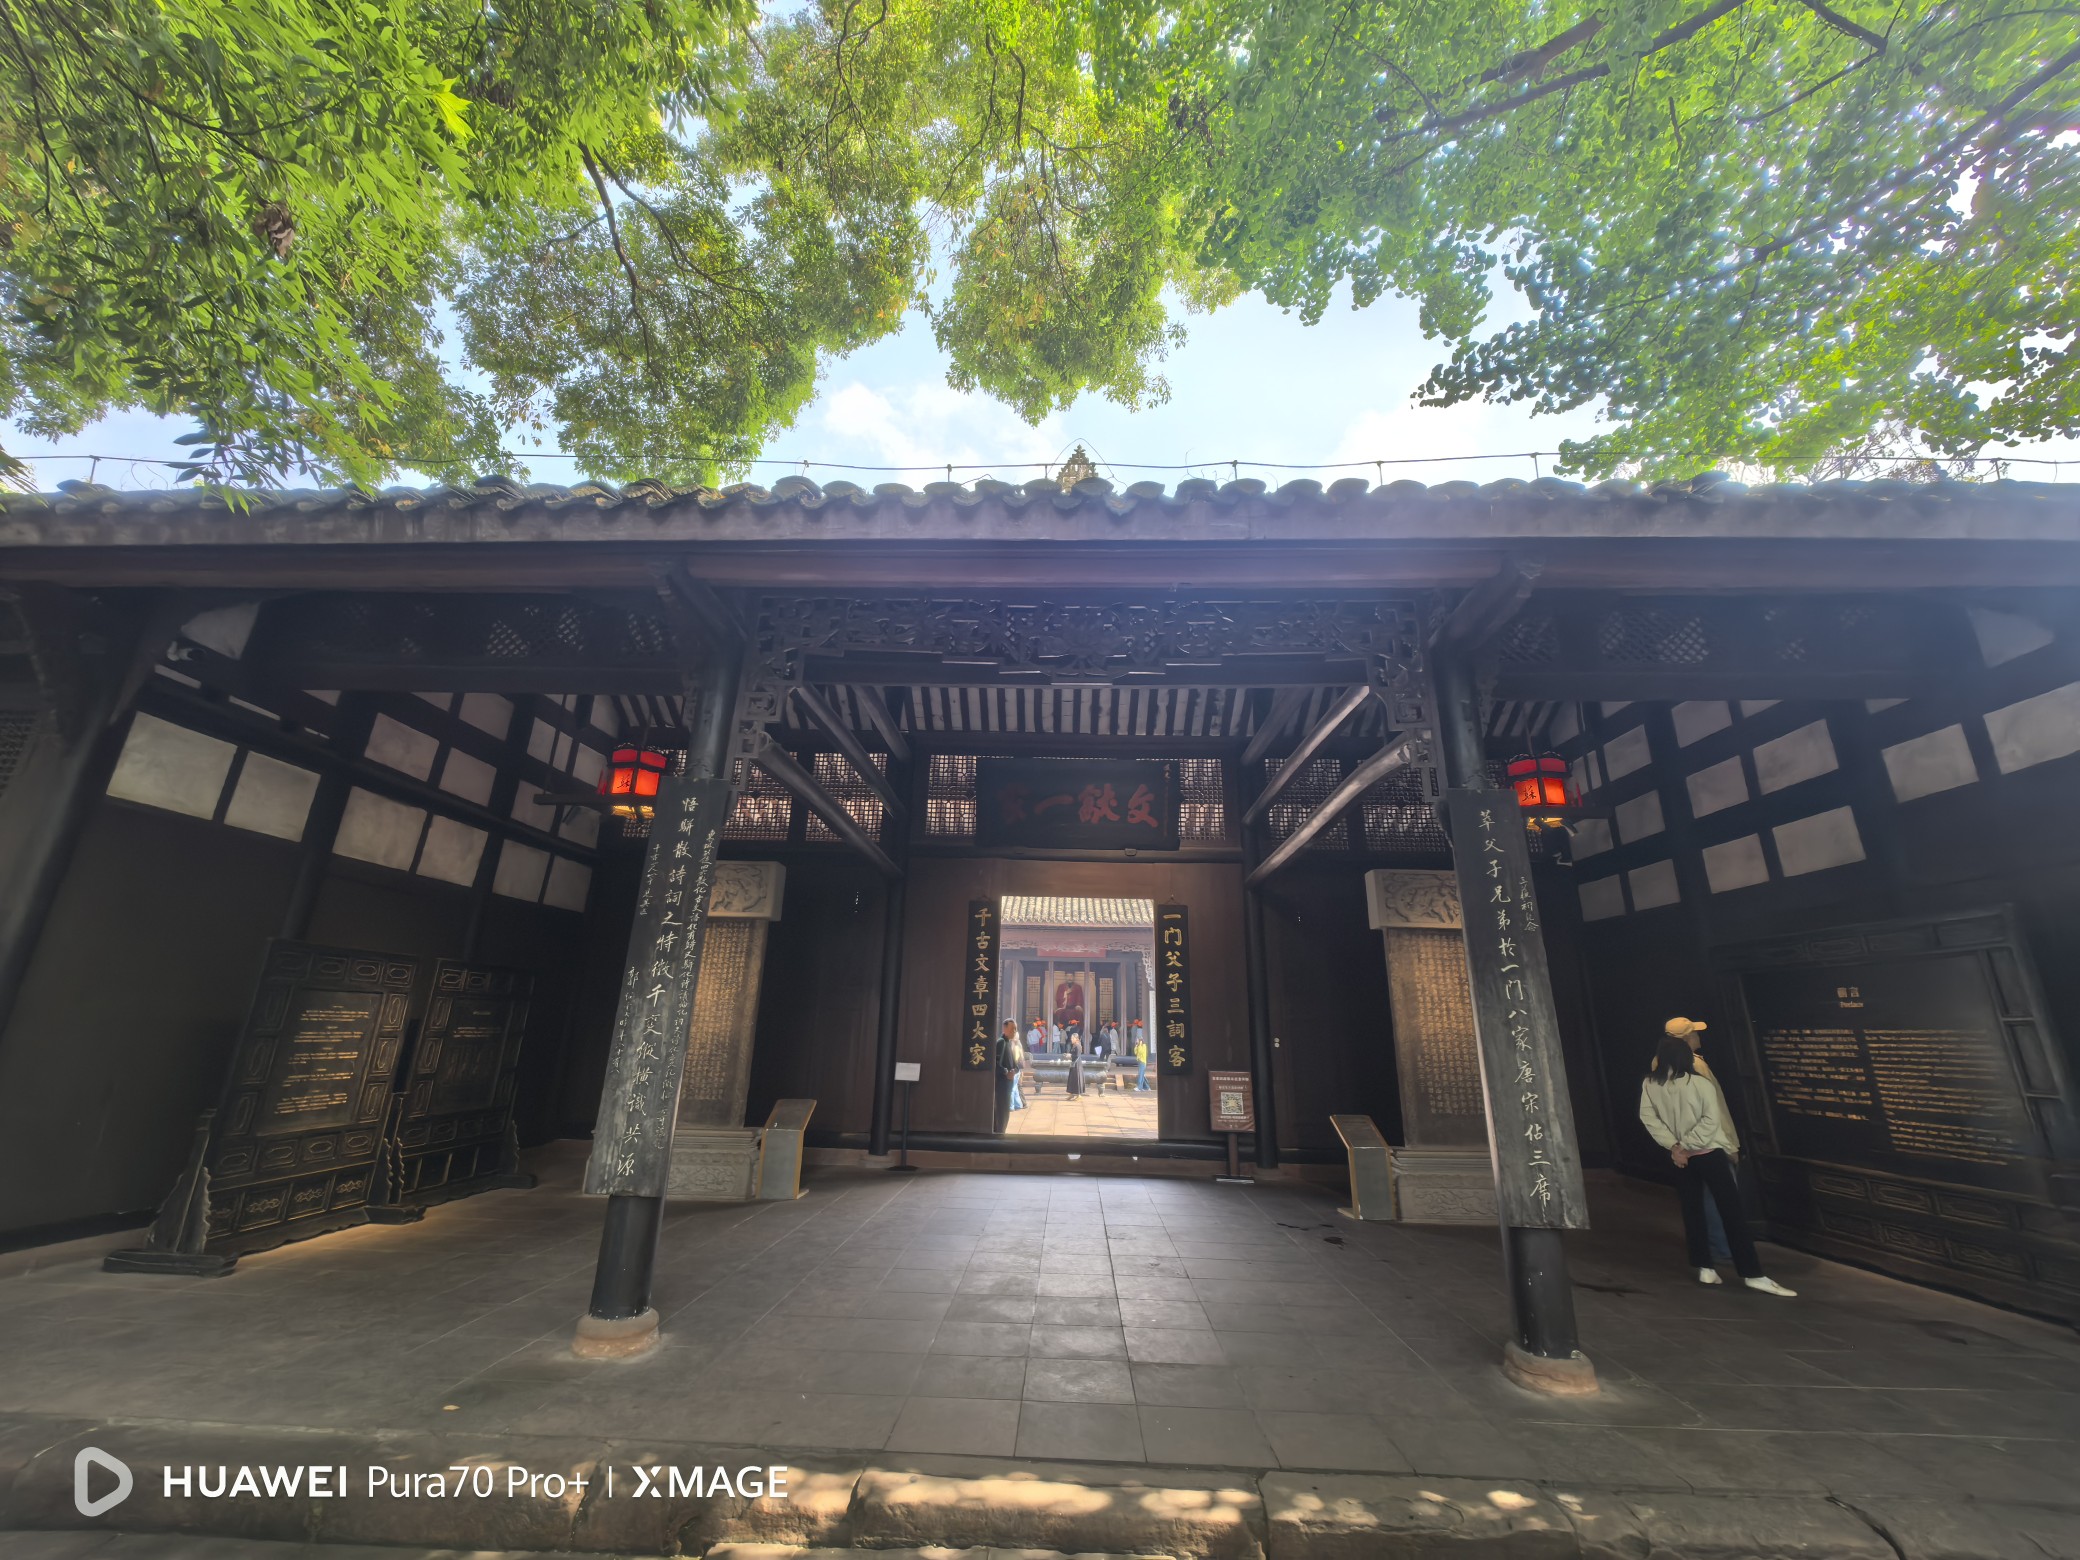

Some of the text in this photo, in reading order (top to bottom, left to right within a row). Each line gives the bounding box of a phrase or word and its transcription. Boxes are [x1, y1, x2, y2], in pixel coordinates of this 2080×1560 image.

[969, 907, 992, 1065] 千古文章四大家
